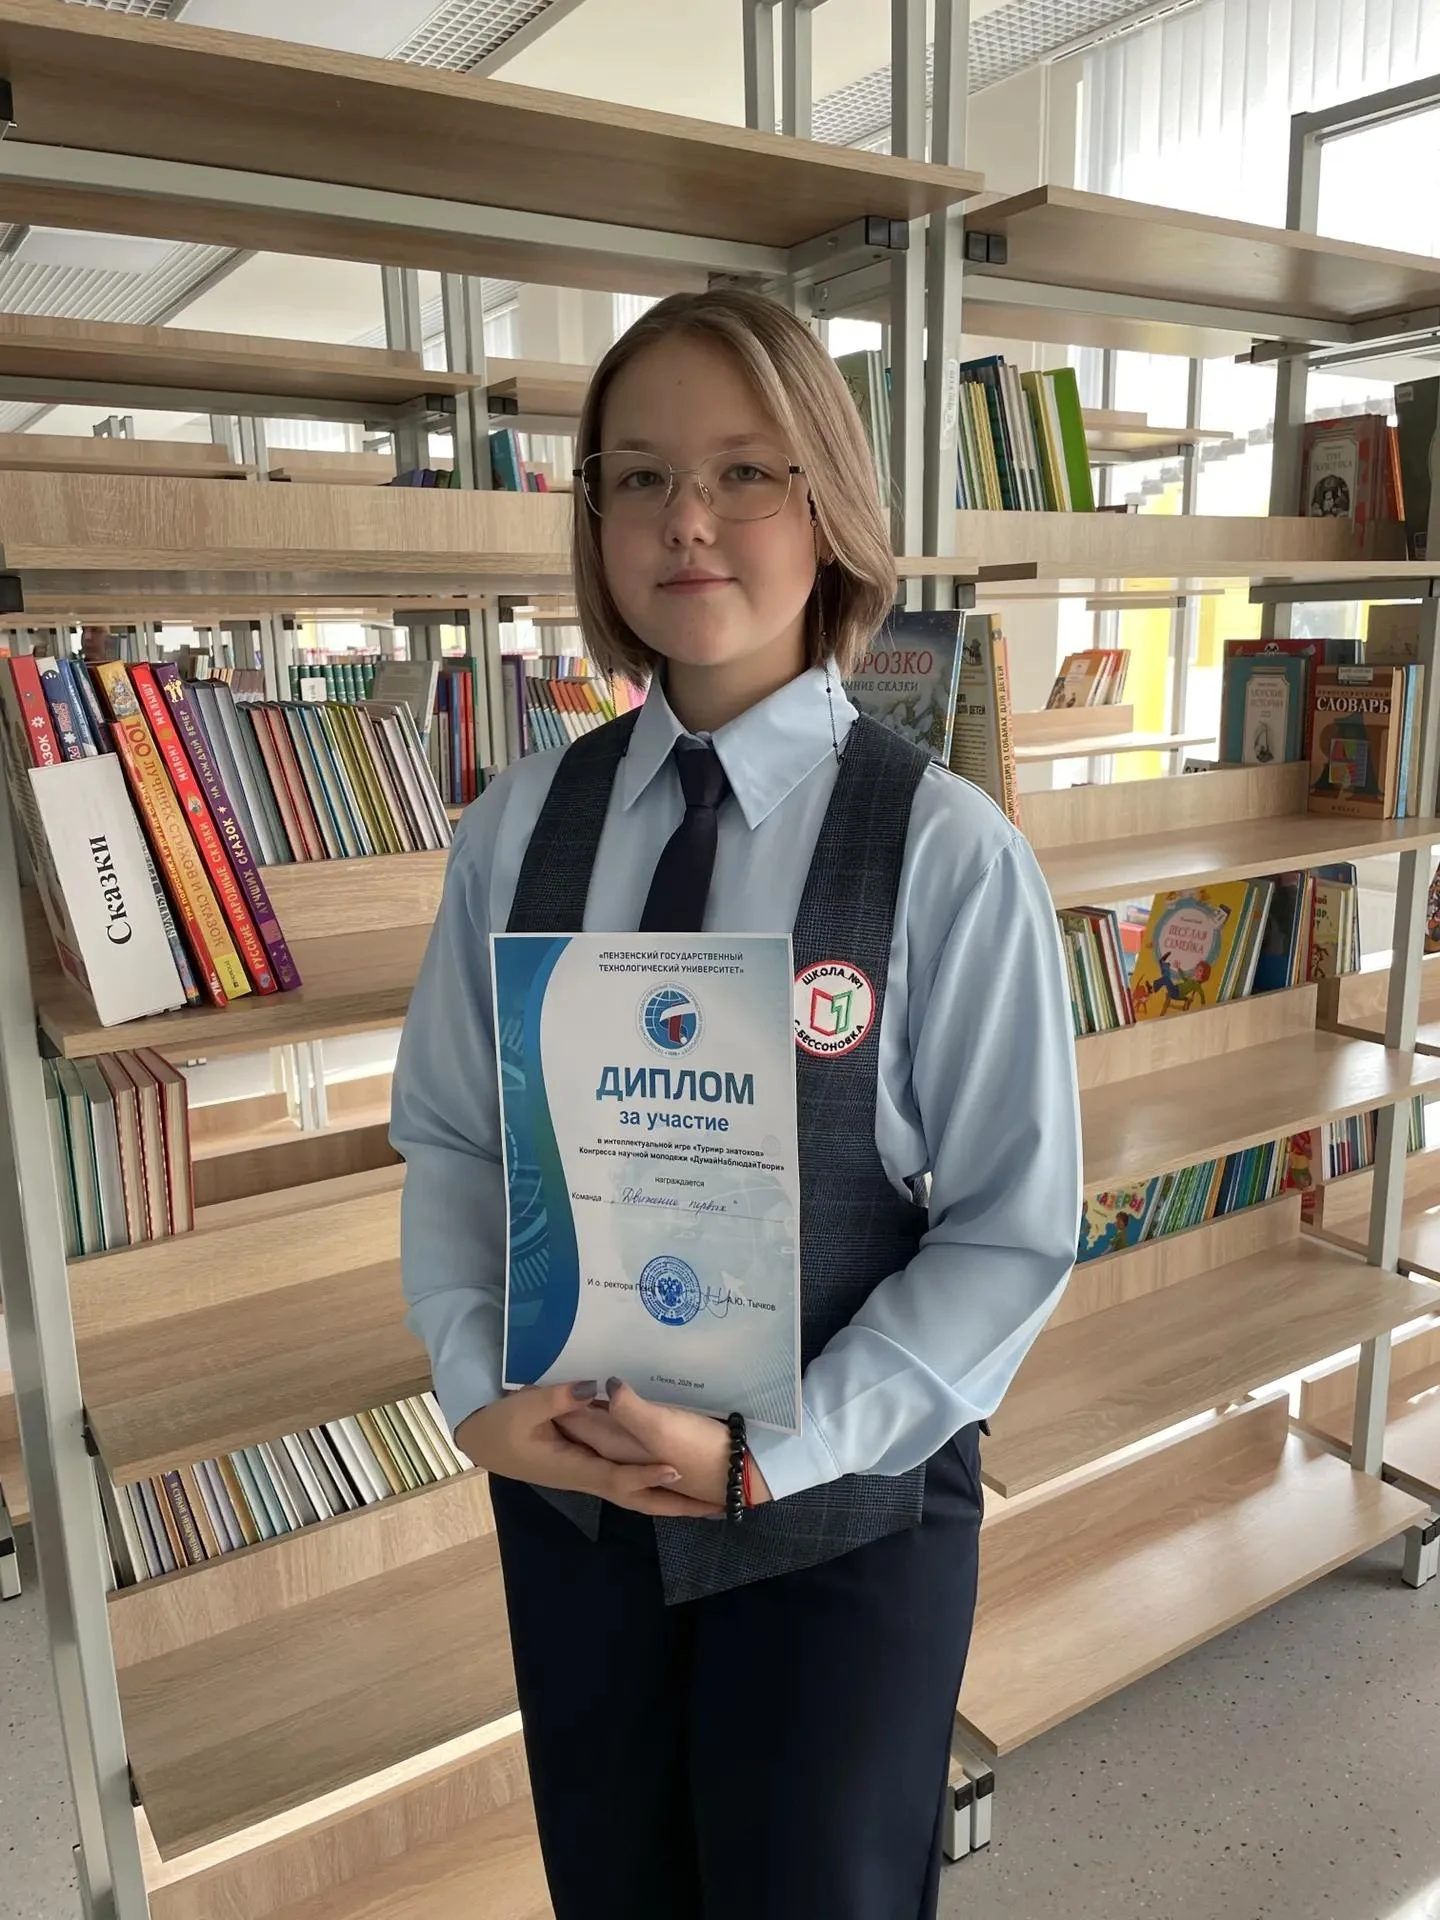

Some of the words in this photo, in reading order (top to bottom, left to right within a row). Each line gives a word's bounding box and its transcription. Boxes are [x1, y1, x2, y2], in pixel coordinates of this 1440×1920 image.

[853, 651, 933, 675] РОЗКО
[141, 683, 167, 726] МАЛЫШУ
[1316, 696, 1389, 714] СЛОВАРЬ
[179, 710, 197, 737] ВЕЧЕР
[37, 734, 54, 766] АЗОК
[190, 739, 215, 783] КАЖДЫЙ
[210, 785, 222, 799] НА
[1004, 762, 1015, 824] НЦИКЛОПЕДИЯ
[126, 720, 152, 757] 100
[143, 761, 175, 821] ЛУЧШИХ
[169, 823, 198, 879] СТИХОВ
[191, 881, 201, 892] И
[196, 893, 225, 949] СКАЗОК
[199, 821, 222, 863] СКАЗКИ
[222, 817, 249, 865] СКАЗОК
[89, 834, 132, 945] Сказки
[216, 866, 246, 923] НАРОДНЫЕ
[243, 868, 268, 914] ЛУЧШИХ
[156, 892, 178, 938] БРАТЬЯ
[184, 904, 194, 921] ТРИ
[240, 923, 265, 970] РУССКИЕ
[599, 951, 659, 960] «ПЕНЗЕНСКИЙ
[660, 951, 744, 961] ГОСУДАРСТВЕННЫЙ
[599, 963, 680, 973] ТЕХНОЛОГИЧЕСКИЙ
[681, 964, 744, 974] УНИВЕРСИТЕТ»
[802, 967, 845, 986] ШКОЛА
[848, 973, 864, 990] №1
[595, 1066, 754, 1105] ДИПЛОМ
[619, 1110, 640, 1125] за
[647, 1112, 729, 1131] участие
[579, 1146, 616, 1156] Конгресса
[618, 1150, 648, 1158] научной
[650, 1153, 688, 1161] молодежи
[690, 1155, 785, 1171] «ДумайНаблюдайТвори»
[604, 1139, 672, 1149] интеллектуальной
[674, 1143, 691, 1151] игре
[693, 1144, 724, 1154] «Турнир
[725, 1148, 764, 1157] знатоков»
[654, 1176, 705, 1188] награждается
[571, 1192, 602, 1202] Команда
[603, 1280, 633, 1290] ректора
[747, 1299, 776, 1311] Тычков
